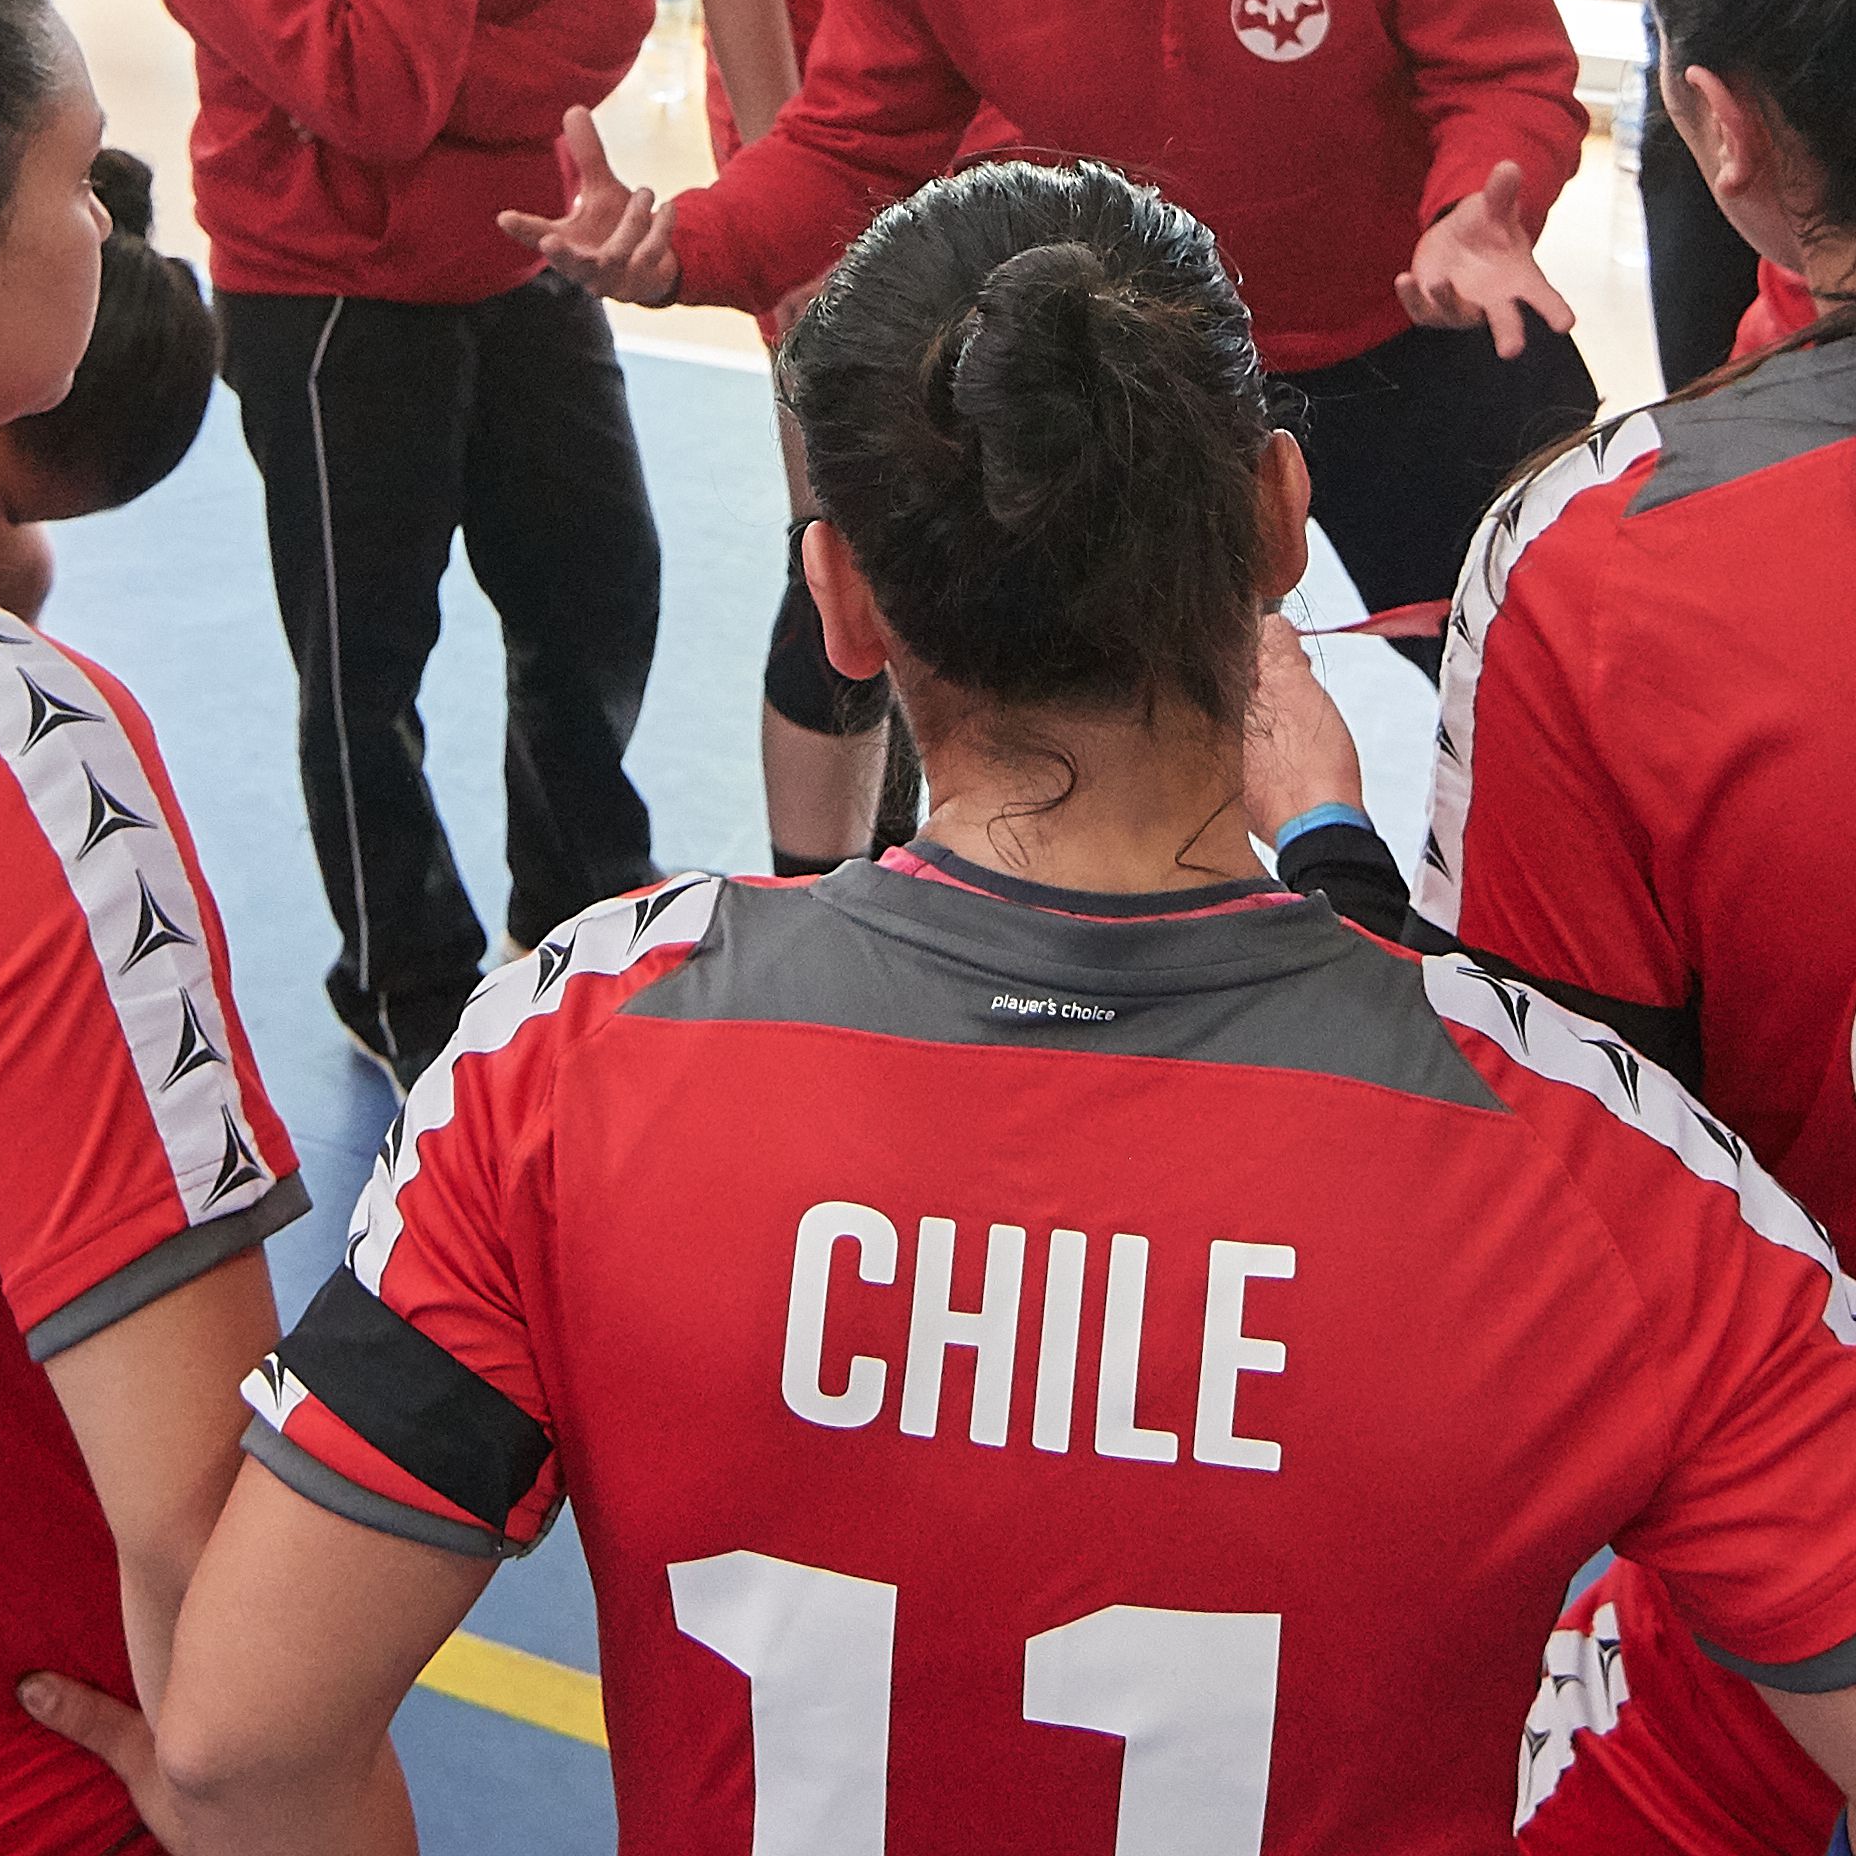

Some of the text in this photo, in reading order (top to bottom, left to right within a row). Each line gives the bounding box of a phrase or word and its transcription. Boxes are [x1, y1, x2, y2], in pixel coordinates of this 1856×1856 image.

[991, 994, 1116, 1022] player's choice
[780, 1199, 1297, 1472] CHILE
[666, 1548, 1282, 1856] 11
